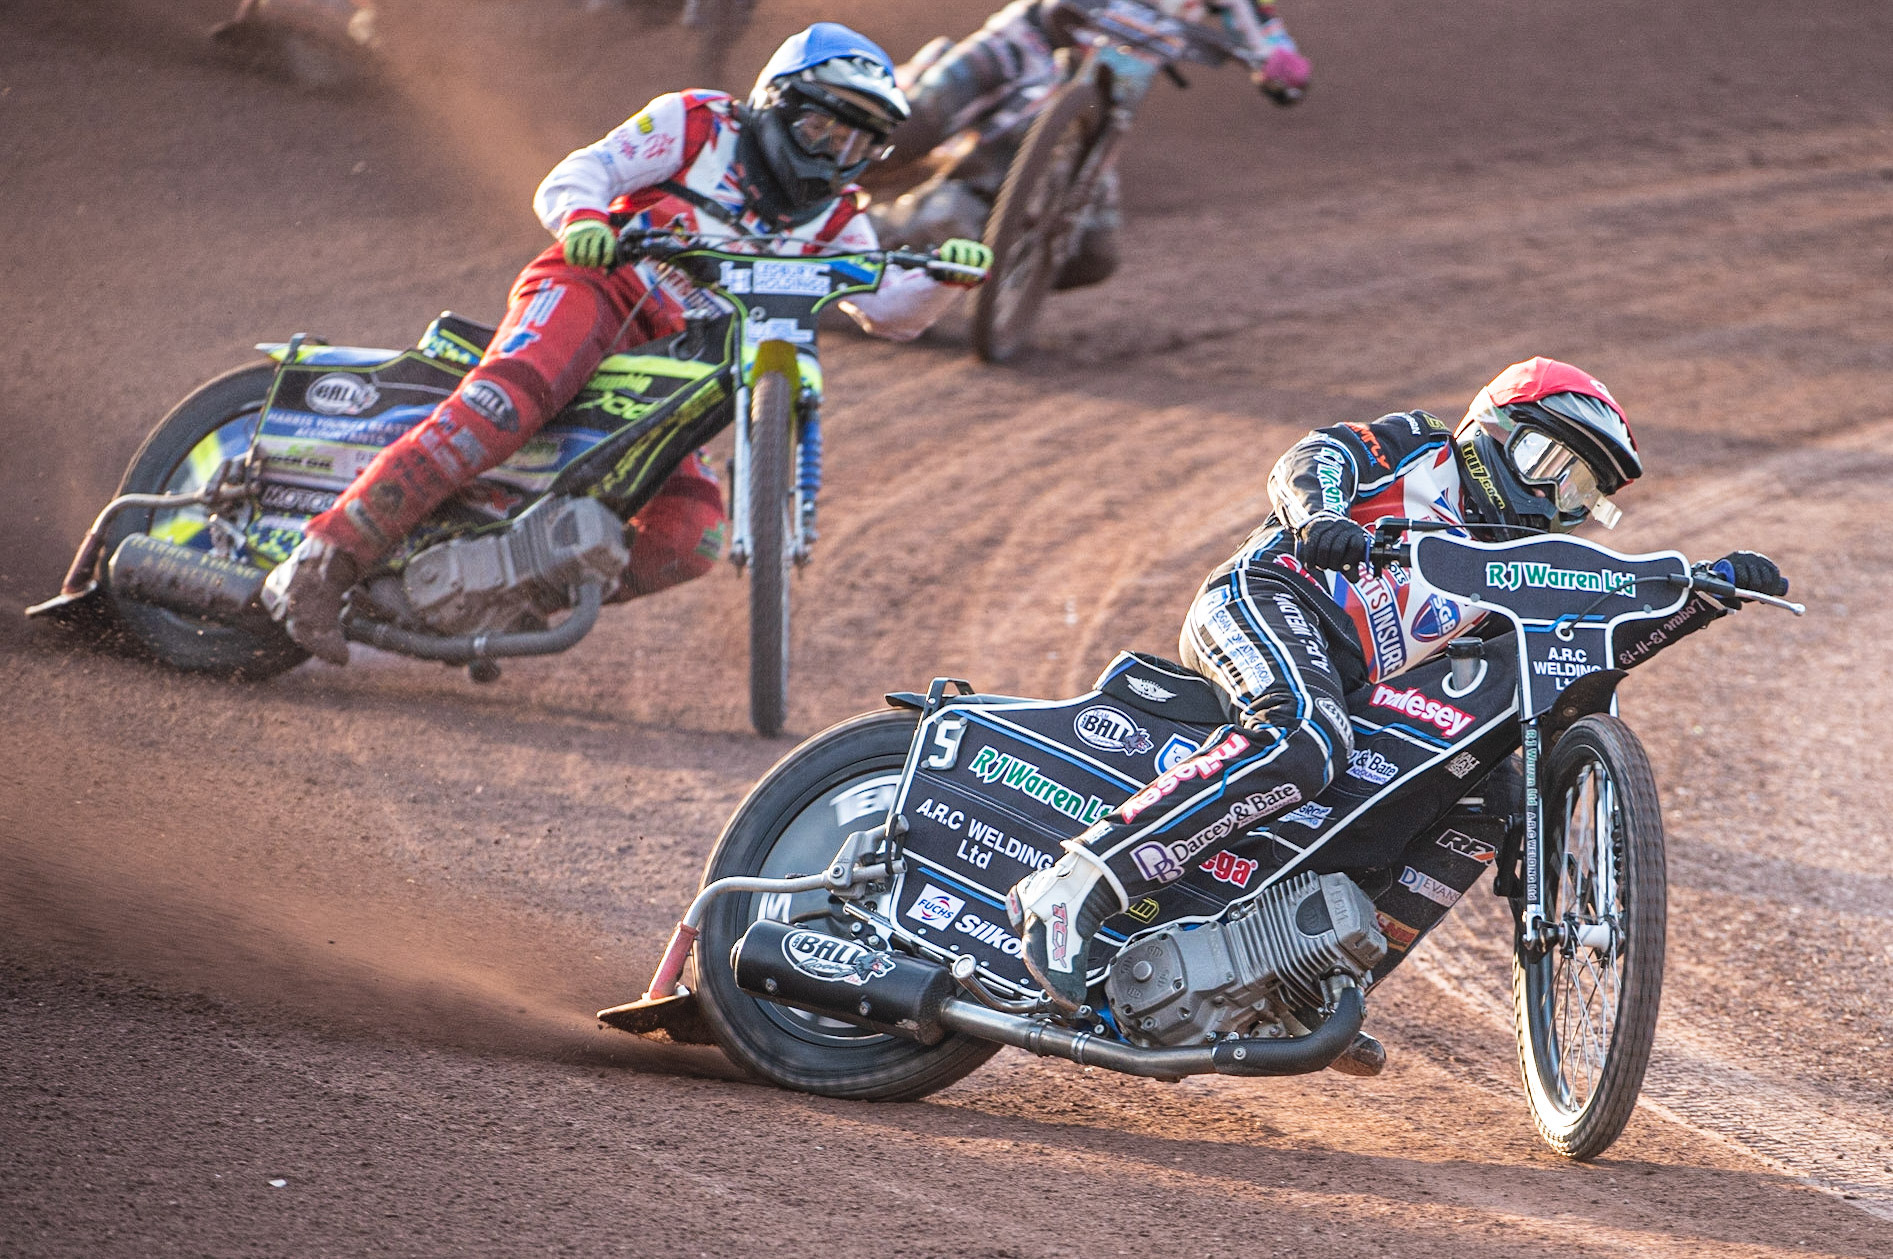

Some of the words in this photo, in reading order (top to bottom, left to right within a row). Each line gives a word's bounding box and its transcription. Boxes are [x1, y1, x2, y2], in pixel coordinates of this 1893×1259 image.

[1601, 569, 1635, 597] Ltd
[1548, 647, 1587, 662] A.R.C
[1556, 678, 1571, 690] Lt
[930, 718, 966, 768] 5
[1371, 755, 1396, 776] Bate
[1082, 795, 1111, 824] Lt
[1172, 818, 1232, 862] Darcey
[1233, 805, 1249, 822] &
[1251, 785, 1296, 813] Bate
[917, 798, 964, 830] A.R.C
[968, 818, 1054, 870] WELDING
[957, 839, 993, 870] Ltd
[917, 898, 954, 920] FUCHS
[955, 914, 1025, 960] Silko
[1052, 903, 1068, 968] TCX
